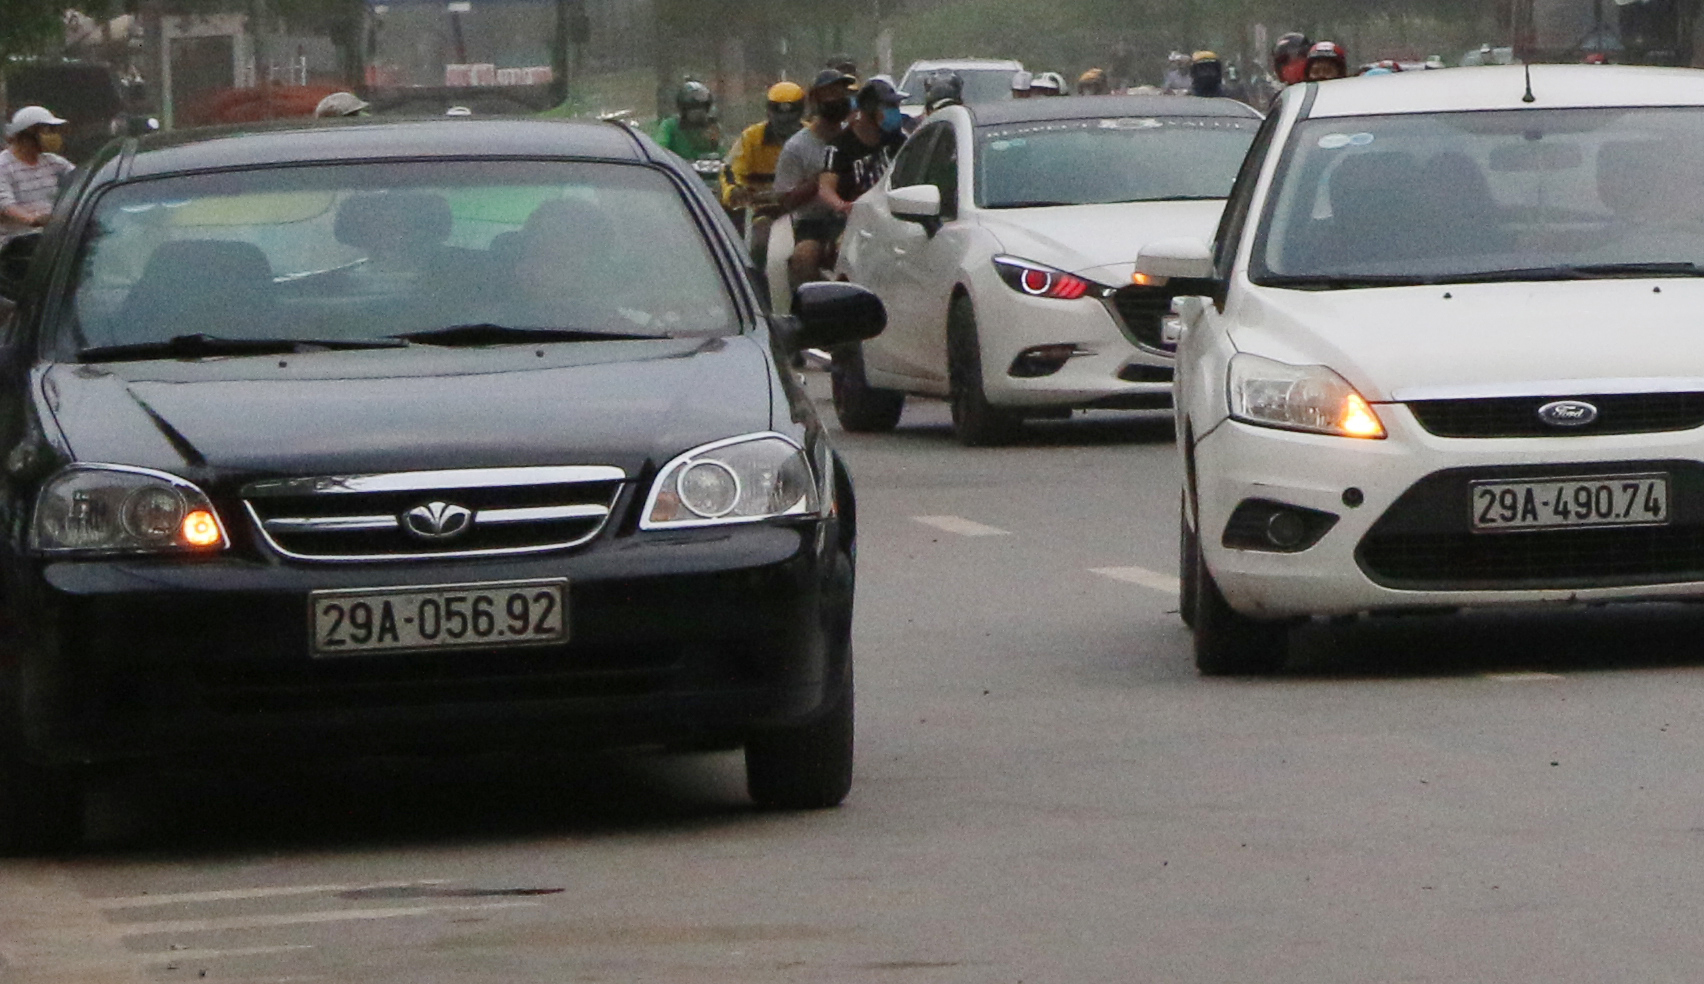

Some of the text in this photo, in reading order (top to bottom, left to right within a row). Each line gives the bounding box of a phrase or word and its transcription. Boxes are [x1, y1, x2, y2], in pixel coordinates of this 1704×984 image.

[1552, 406, 1584, 417] Ford
[1478, 483, 1661, 523] 29A-490.74
[323, 591, 556, 645] 29A-056.92
